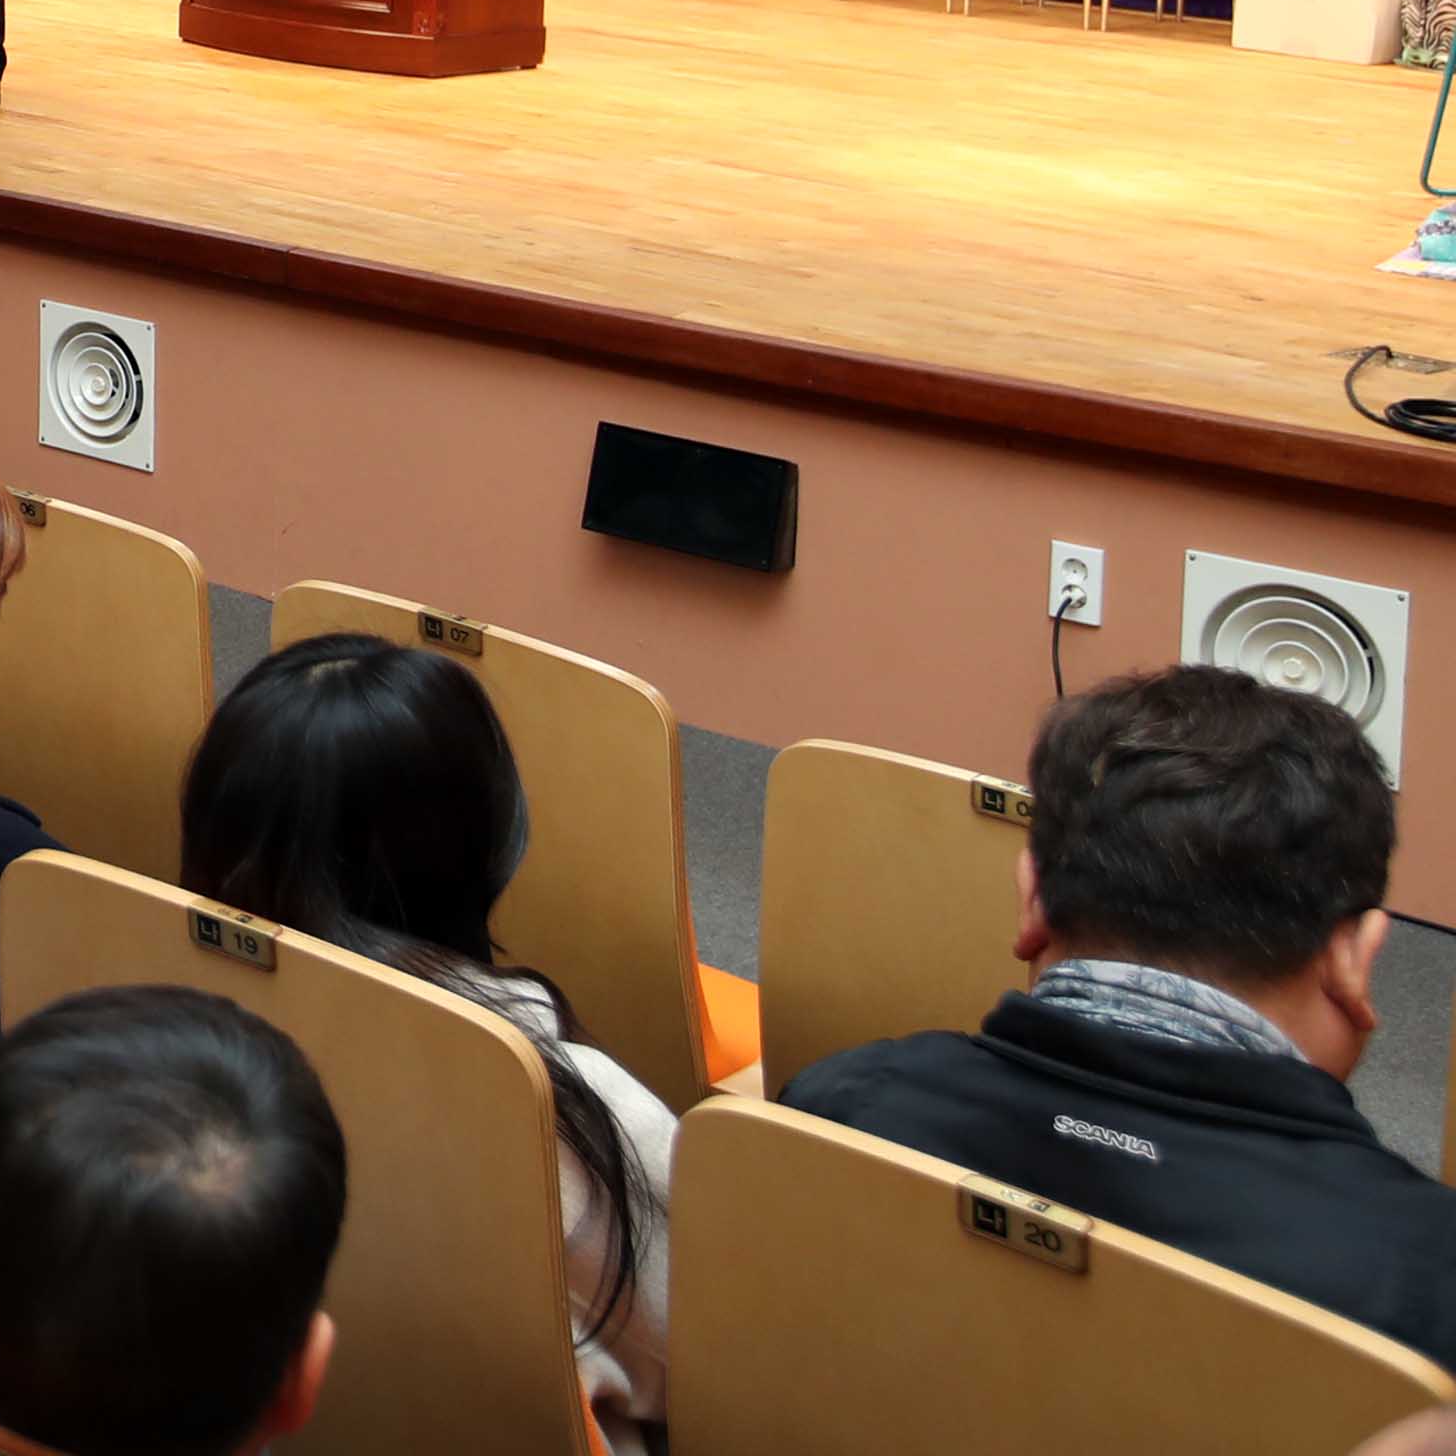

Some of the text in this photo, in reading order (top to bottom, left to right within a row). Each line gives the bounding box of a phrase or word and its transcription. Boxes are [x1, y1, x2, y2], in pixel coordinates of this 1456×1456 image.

[449, 626, 470, 644] 07
[233, 932, 258, 955] 19
[1052, 1114, 1157, 1160] SCANIA
[1023, 1221, 1062, 1253] 20
